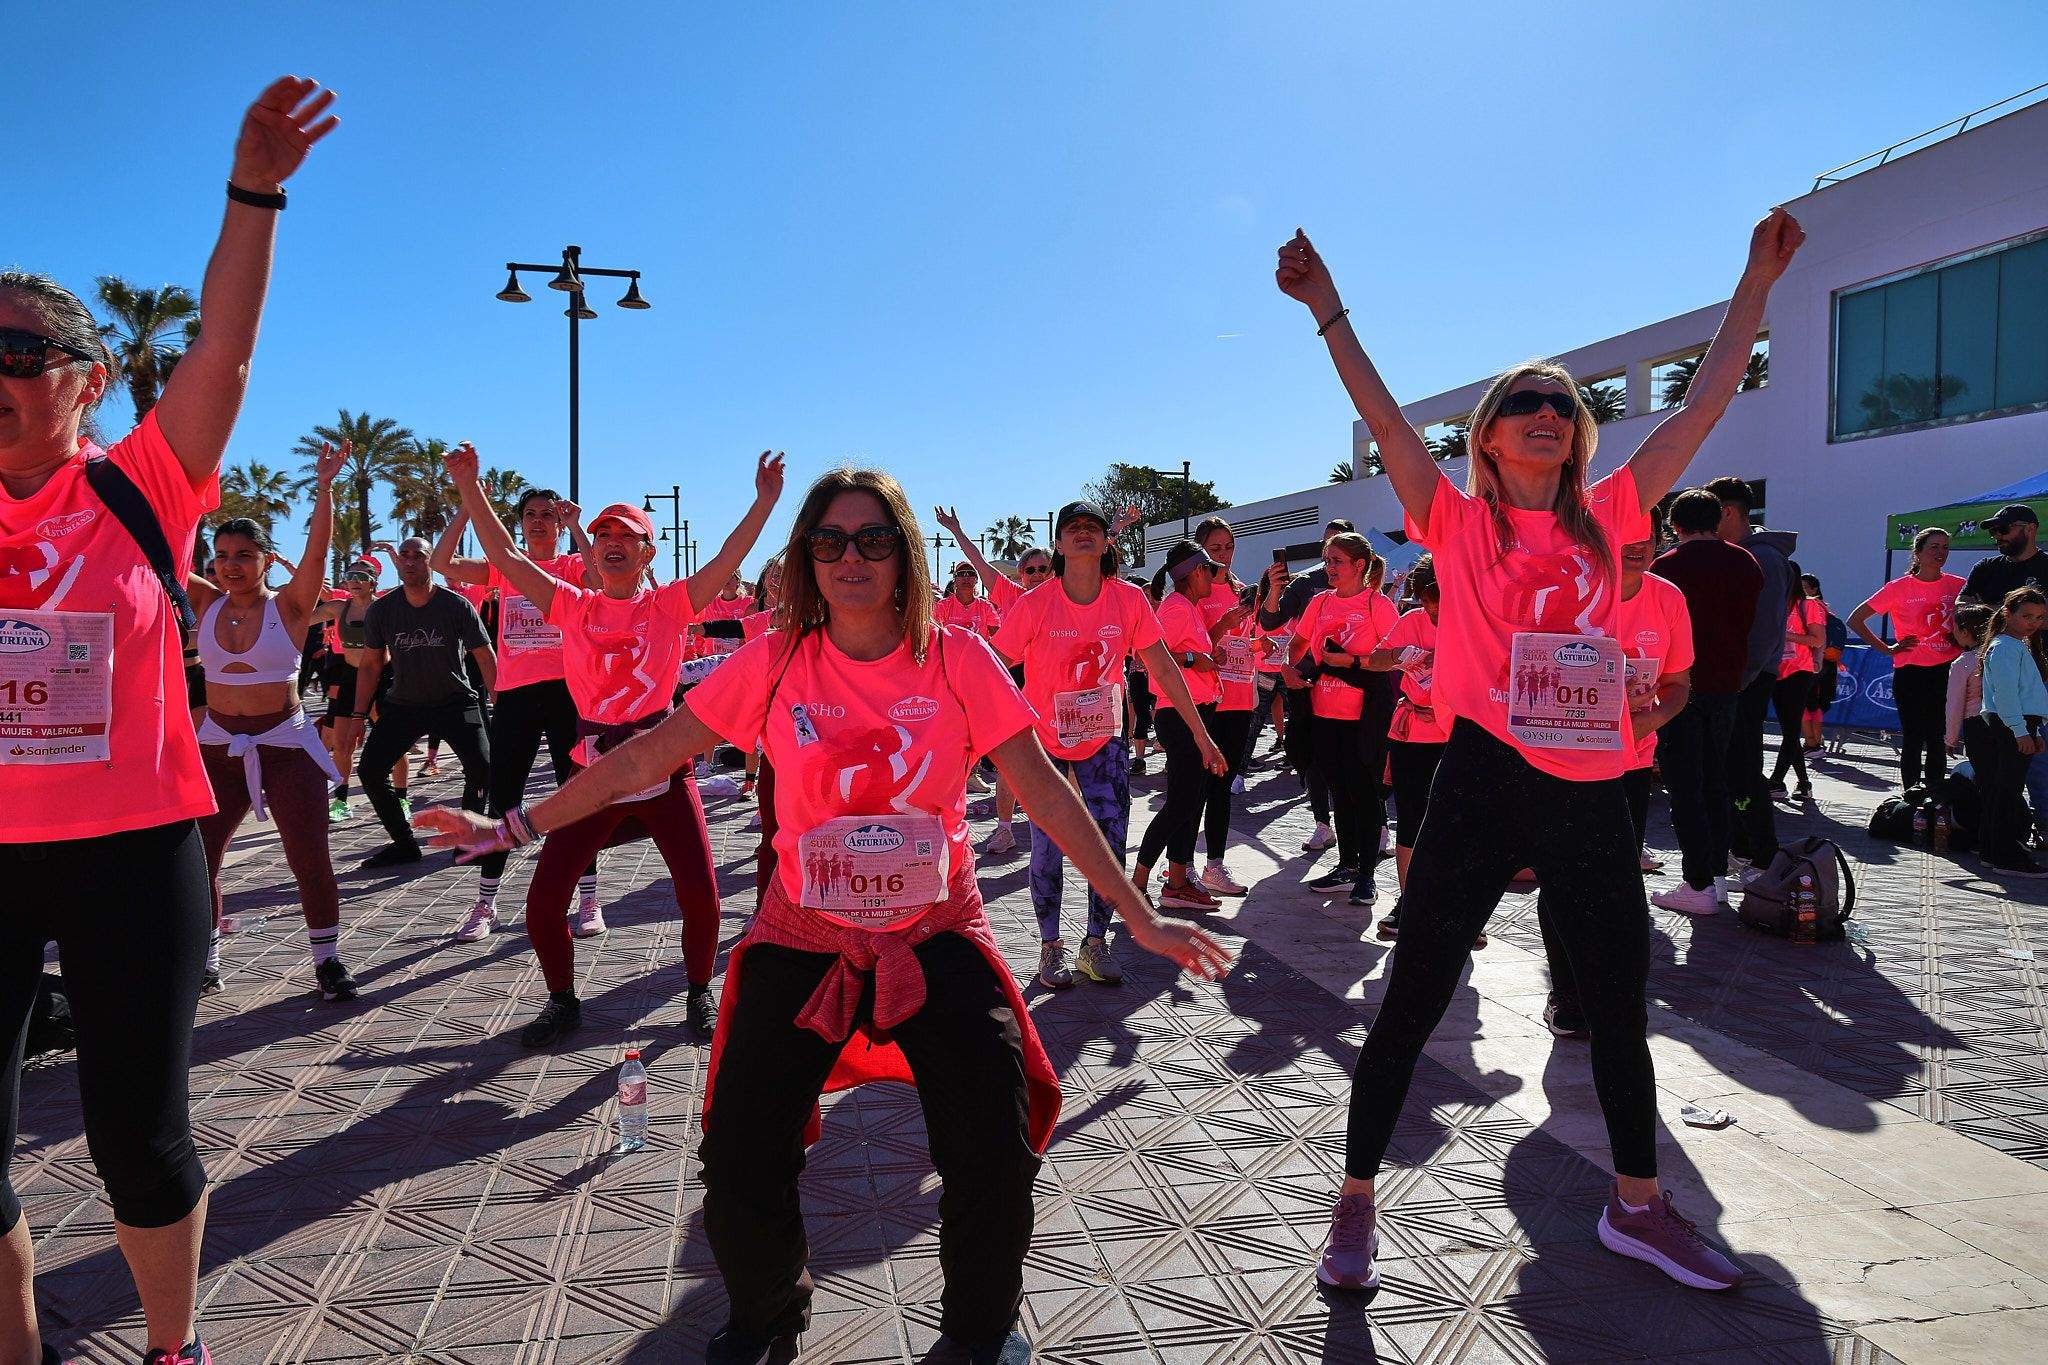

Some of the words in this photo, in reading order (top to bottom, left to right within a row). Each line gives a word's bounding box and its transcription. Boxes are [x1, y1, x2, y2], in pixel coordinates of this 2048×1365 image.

[521, 619, 543, 627] 016
[1049, 630, 1078, 638] OYSHO
[1229, 656, 1245, 665] 016
[1522, 653, 1548, 662] SUMA
[1558, 651, 1598, 662] ASTURIANA
[1556, 686, 1599, 705] 016
[892, 705, 937, 717] ASTURIANA
[1564, 709, 1586, 718] 7739
[1080, 713, 1104, 725] 016
[1525, 718, 1553, 727] CARRERA
[1, 727, 33, 736] MUJER
[41, 726, 84, 736] VALENCIA
[1522, 730, 1563, 742] OYSHO
[26, 744, 86, 756] Santander
[810, 840, 838, 849] SUMA
[848, 836, 900, 847] ASTURIANA
[850, 873, 905, 894] 016
[862, 898, 886, 907] 1191
[861, 909, 870, 917] LA
[871, 907, 894, 917] MUJER
